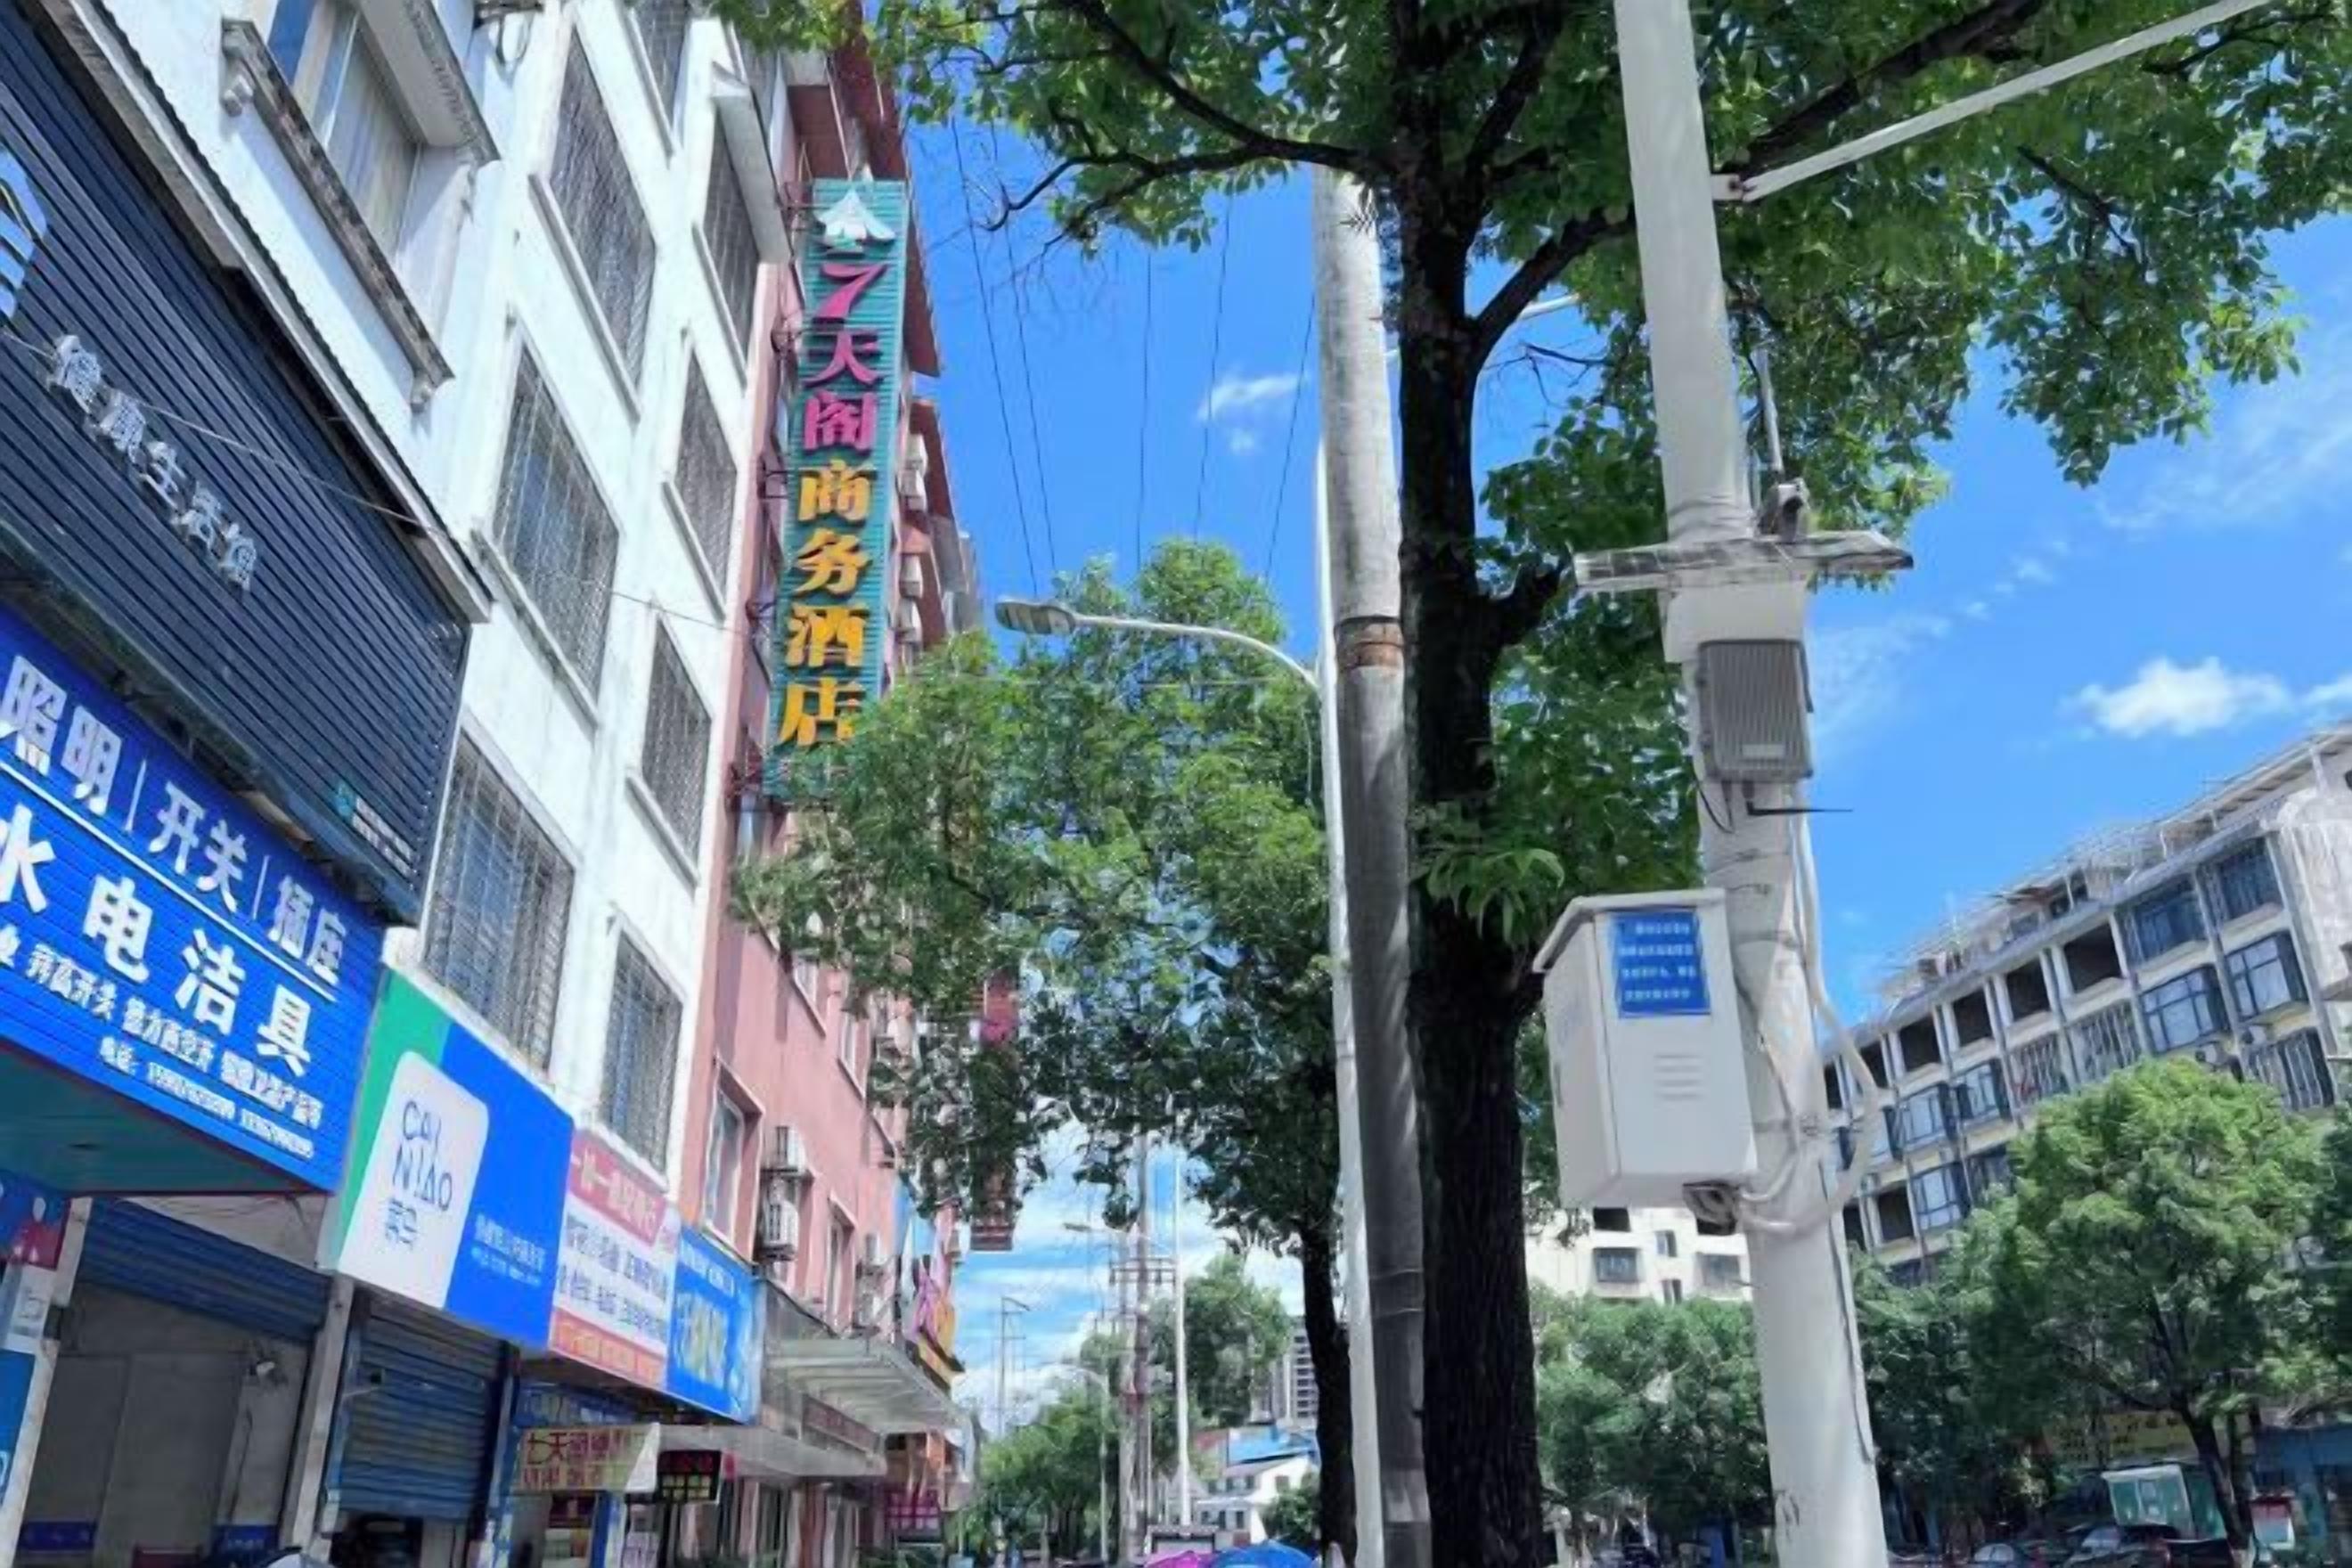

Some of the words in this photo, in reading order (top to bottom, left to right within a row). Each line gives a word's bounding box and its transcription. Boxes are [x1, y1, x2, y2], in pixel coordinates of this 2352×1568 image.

[0, 655, 122, 816] 照明
[147, 781, 248, 913] 开关
[0, 803, 311, 1077] 水电洁具
